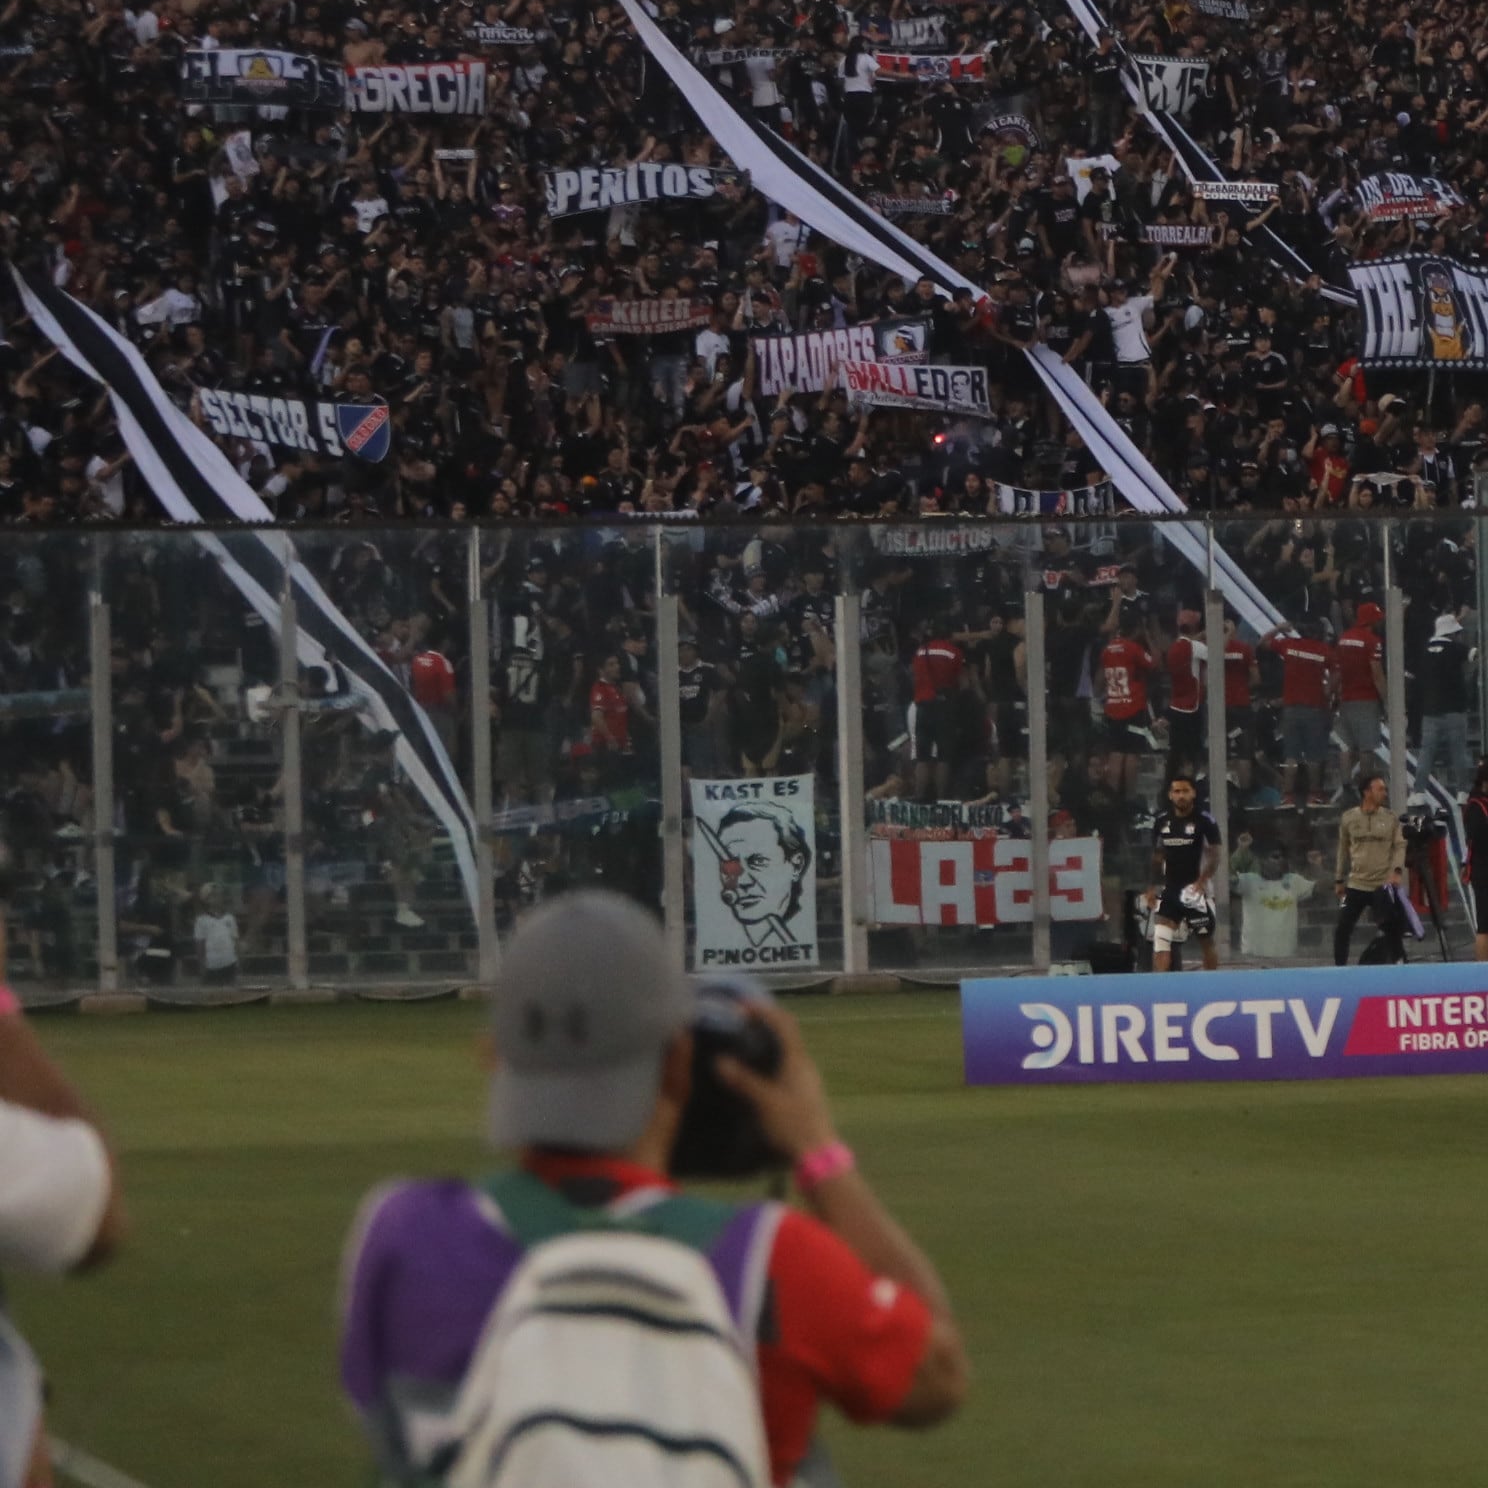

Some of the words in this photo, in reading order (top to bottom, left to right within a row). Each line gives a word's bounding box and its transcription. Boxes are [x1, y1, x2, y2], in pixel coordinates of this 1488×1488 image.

[705, 783, 764, 801] KAST
[774, 780, 800, 797] ES
[703, 944, 814, 964] PINOCHET
[1020, 997, 1341, 1070] DIRECTV
[1400, 1031, 1459, 1052] FIBRA
